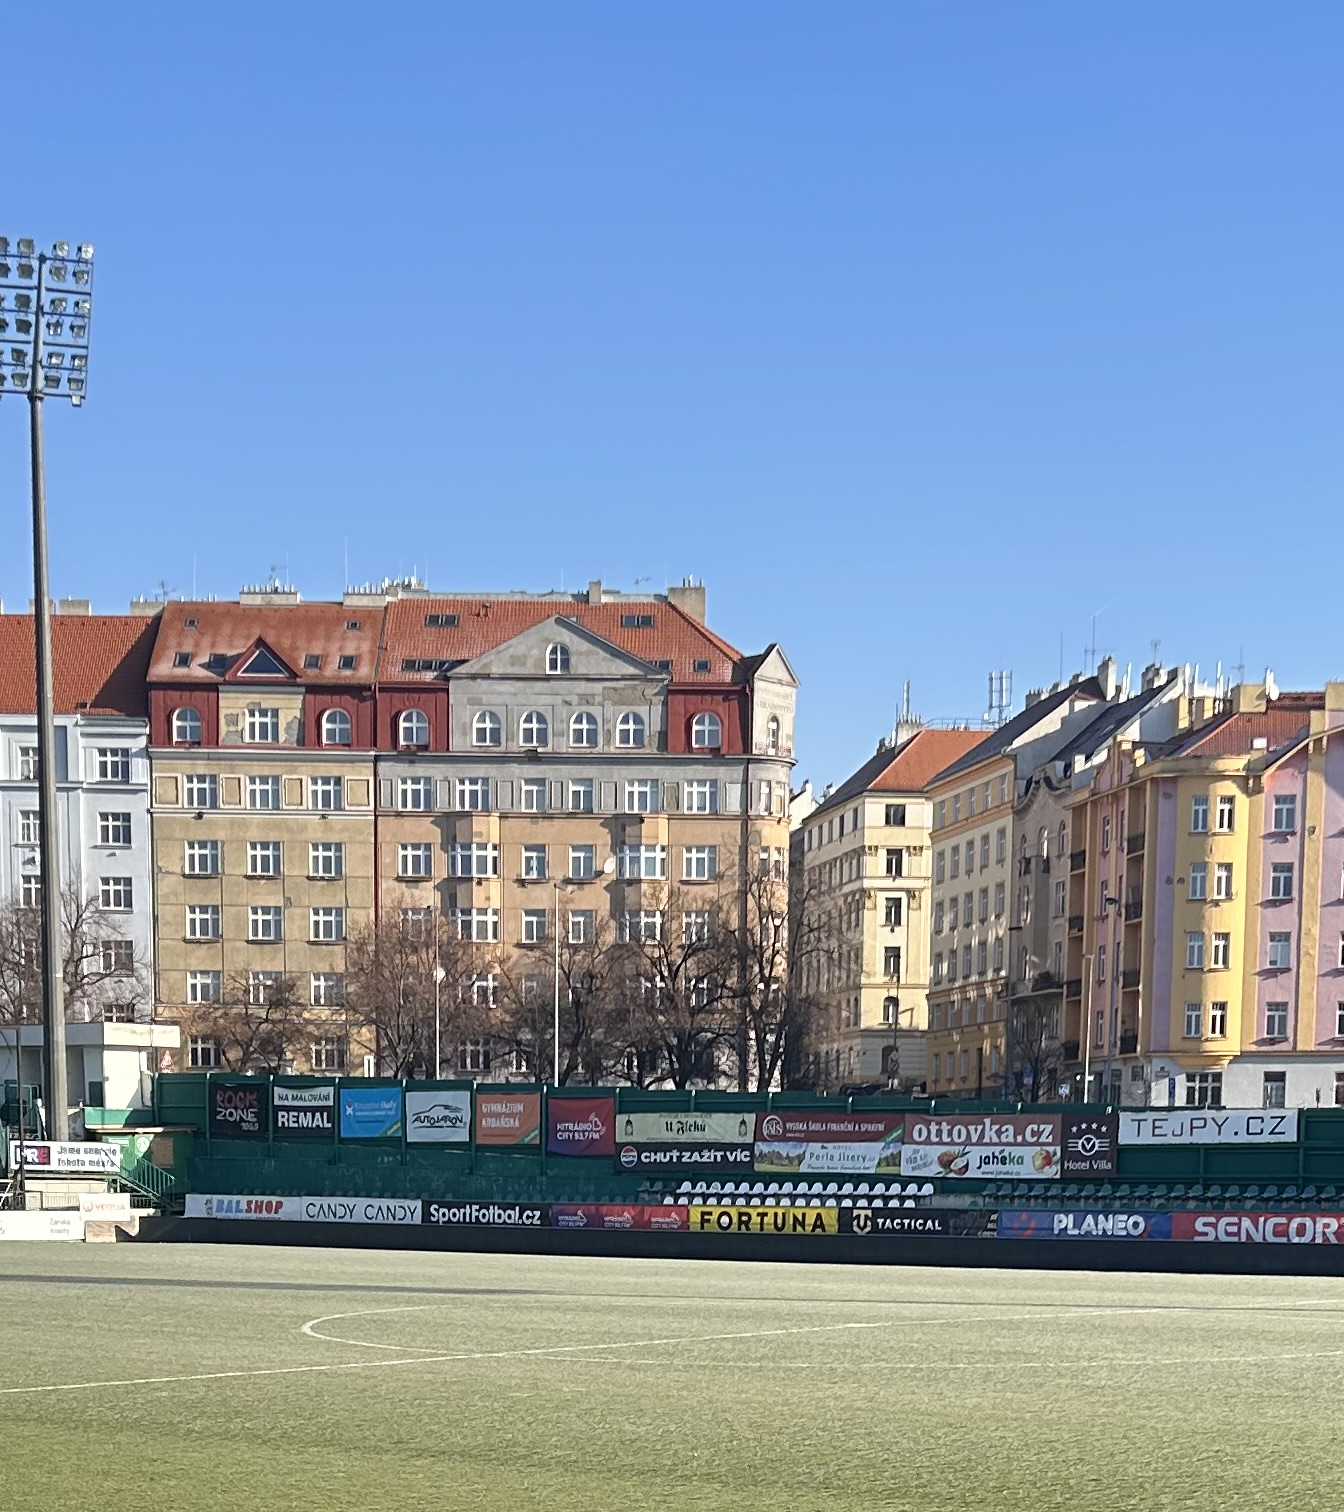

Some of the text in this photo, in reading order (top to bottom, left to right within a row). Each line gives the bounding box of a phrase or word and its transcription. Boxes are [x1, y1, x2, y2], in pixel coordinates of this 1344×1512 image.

[216, 1091, 259, 1109] ROCK
[277, 1092, 331, 1103] NA MALOVÁNÍ
[216, 1108, 258, 1122] ZONE
[277, 1111, 332, 1128] REMAL
[556, 1131, 574, 1140] CITY
[912, 1118, 1054, 1143] ottovka.cz
[640, 1148, 752, 1163] CHUŤ ZAŽÍT VÍC
[809, 1152, 834, 1162] Perla
[1064, 1160, 1112, 1170] Hotel Villa
[306, 1202, 417, 1221] CANDY CANDY
[429, 1204, 541, 1225] SportFotbal.cz
[700, 1211, 826, 1233] FORTUNA
[876, 1218, 942, 1231] TACTICAL
[1053, 1213, 1146, 1236] PLANEO
[1193, 1216, 1339, 1243] SENCOR
